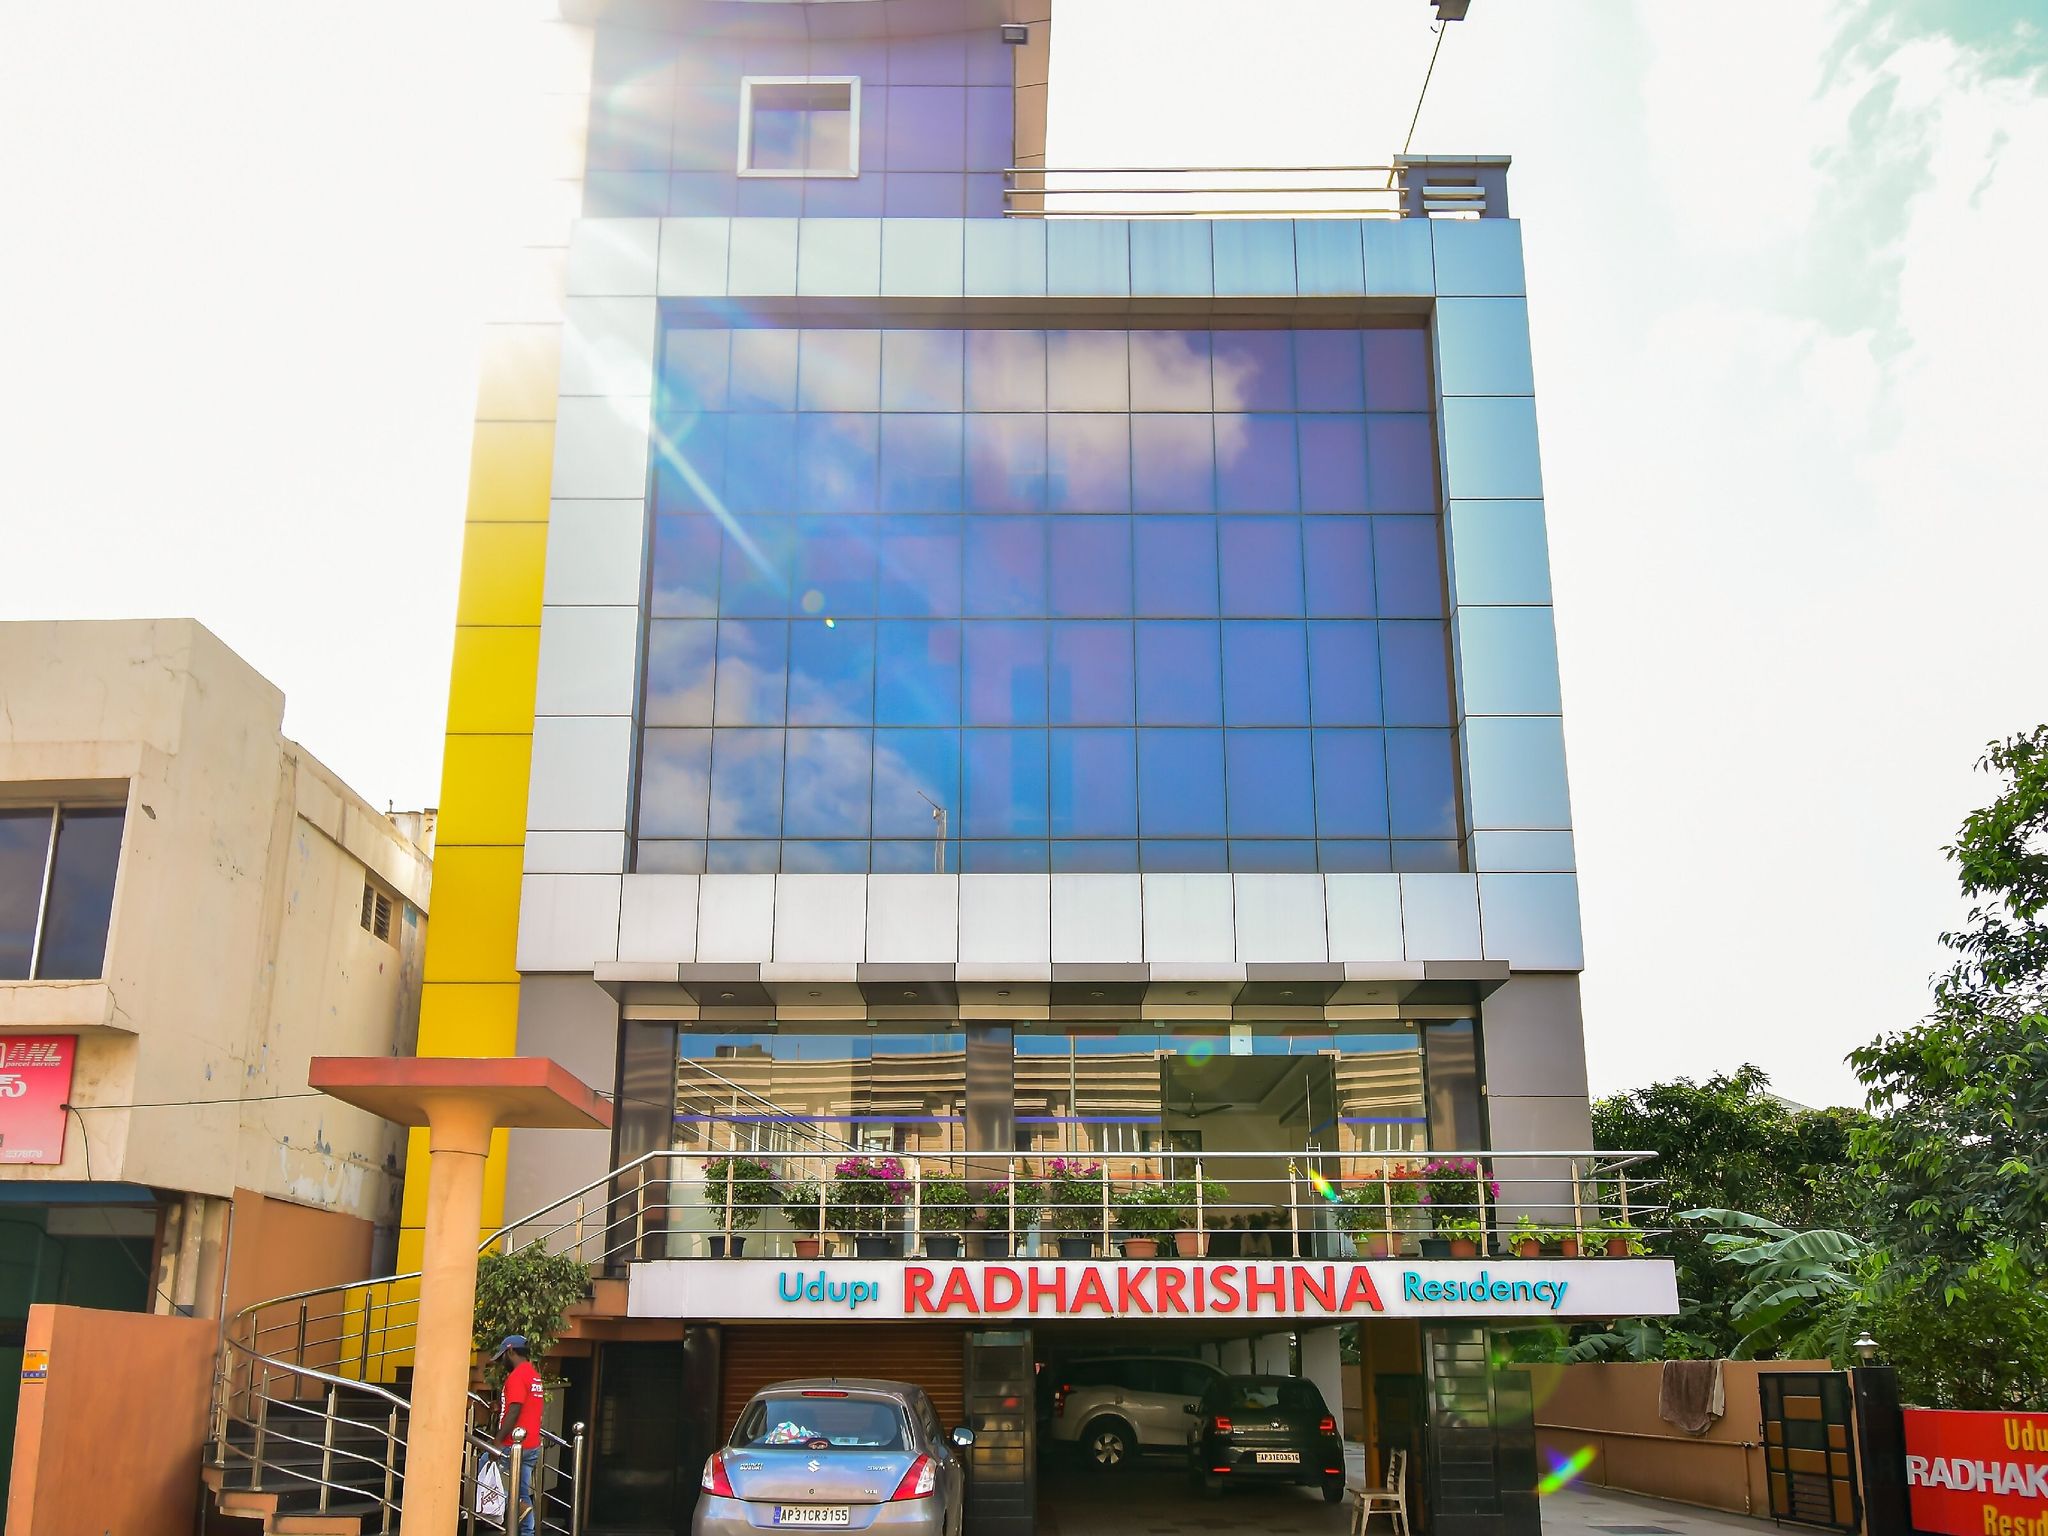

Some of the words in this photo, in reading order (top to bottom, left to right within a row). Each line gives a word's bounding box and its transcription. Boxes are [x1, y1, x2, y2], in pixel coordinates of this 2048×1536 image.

[779, 1270, 879, 1310] Udupi
[904, 1266, 1385, 1313] RADHAKRISHNA
[1403, 1270, 1568, 1310] Residency
[1906, 1455, 2048, 1498] RADHAK
[781, 1509, 848, 1522] AP31CR3155
